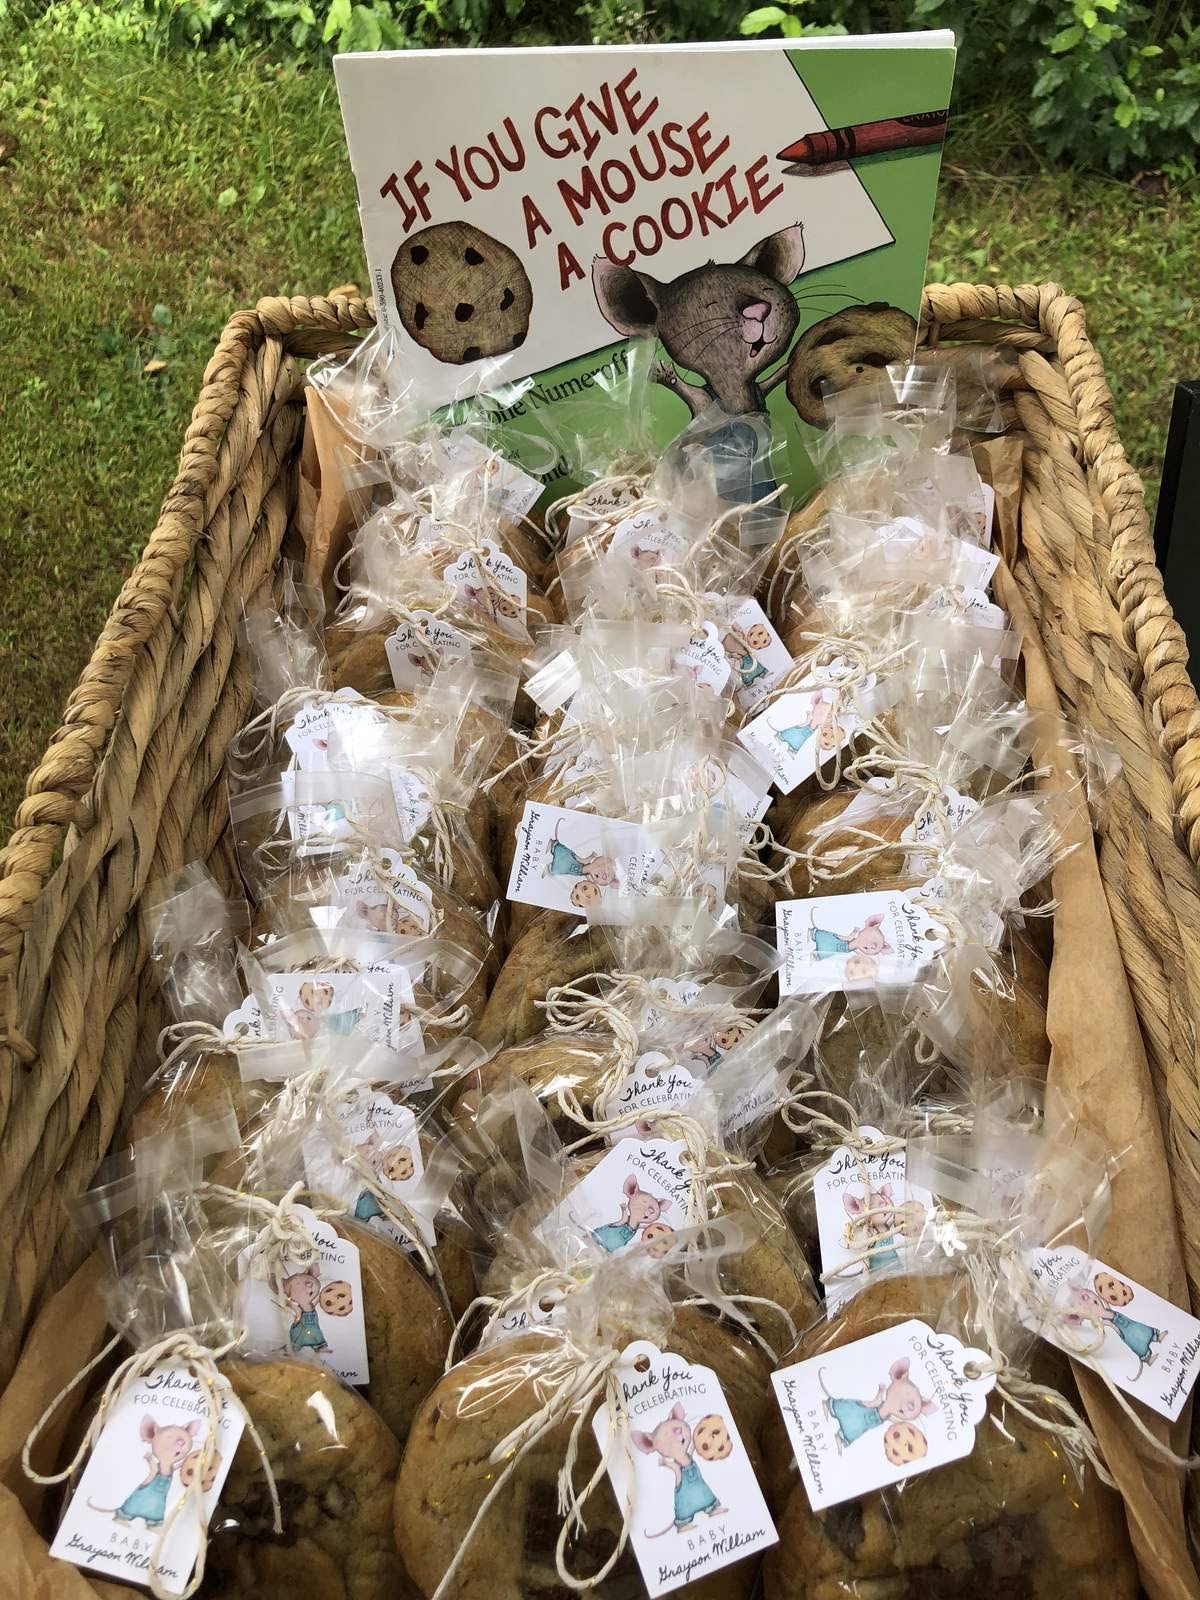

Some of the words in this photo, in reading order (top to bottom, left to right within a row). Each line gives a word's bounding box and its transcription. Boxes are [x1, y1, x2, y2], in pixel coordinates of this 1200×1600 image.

[380, 159, 432, 234] IF
[435, 116, 527, 203] YOU
[534, 67, 660, 162] GIVE
[521, 194, 551, 250] A
[556, 111, 732, 228] MOUSE
[556, 241, 586, 291] A
[602, 154, 786, 269] COOKIE
[527, 349, 628, 410] Numeroff
[456, 557, 494, 571] Thk
[492, 559, 514, 574] You
[396, 626, 432, 642] Thk
[433, 627, 454, 641] You
[702, 645, 721, 664] You
[296, 708, 330, 729] Thank
[521, 810, 541, 852] Grayson
[531, 840, 542, 872] BABY
[514, 852, 533, 894] William
[887, 900, 901, 918] FOR
[901, 902, 924, 943] Thank
[776, 907, 793, 946] Grayson
[904, 943, 924, 961] Yo
[620, 1076, 666, 1102] Thank
[366, 1102, 394, 1124] You
[618, 1102, 639, 1116] FOR
[626, 1153, 646, 1171] FOR
[640, 1147, 686, 1180] Thank
[827, 1177, 848, 1190] FOR
[1040, 1254, 1063, 1276] You
[1161, 1343, 1182, 1374] BABY
[145, 1370, 202, 1392] Thank
[620, 1369, 660, 1406] hank
[662, 1366, 694, 1392] You
[907, 1334, 928, 1361] FOR
[924, 1361, 958, 1442] CELEBRATING
[926, 1333, 970, 1389] Thank
[948, 1389, 974, 1428] You
[1160, 1366, 1189, 1409] Grayson
[134, 1394, 158, 1405] FOR
[634, 1383, 707, 1414] CELEBRATING
[782, 1379, 805, 1433] Grayson
[802, 1434, 825, 1495] William
[807, 1408, 829, 1451] BABY
[65, 1533, 121, 1564] Grayson
[109, 1532, 152, 1551] BABY
[687, 1523, 728, 1551] BABY
[658, 1552, 712, 1585] Grayson
[712, 1528, 766, 1558] William
